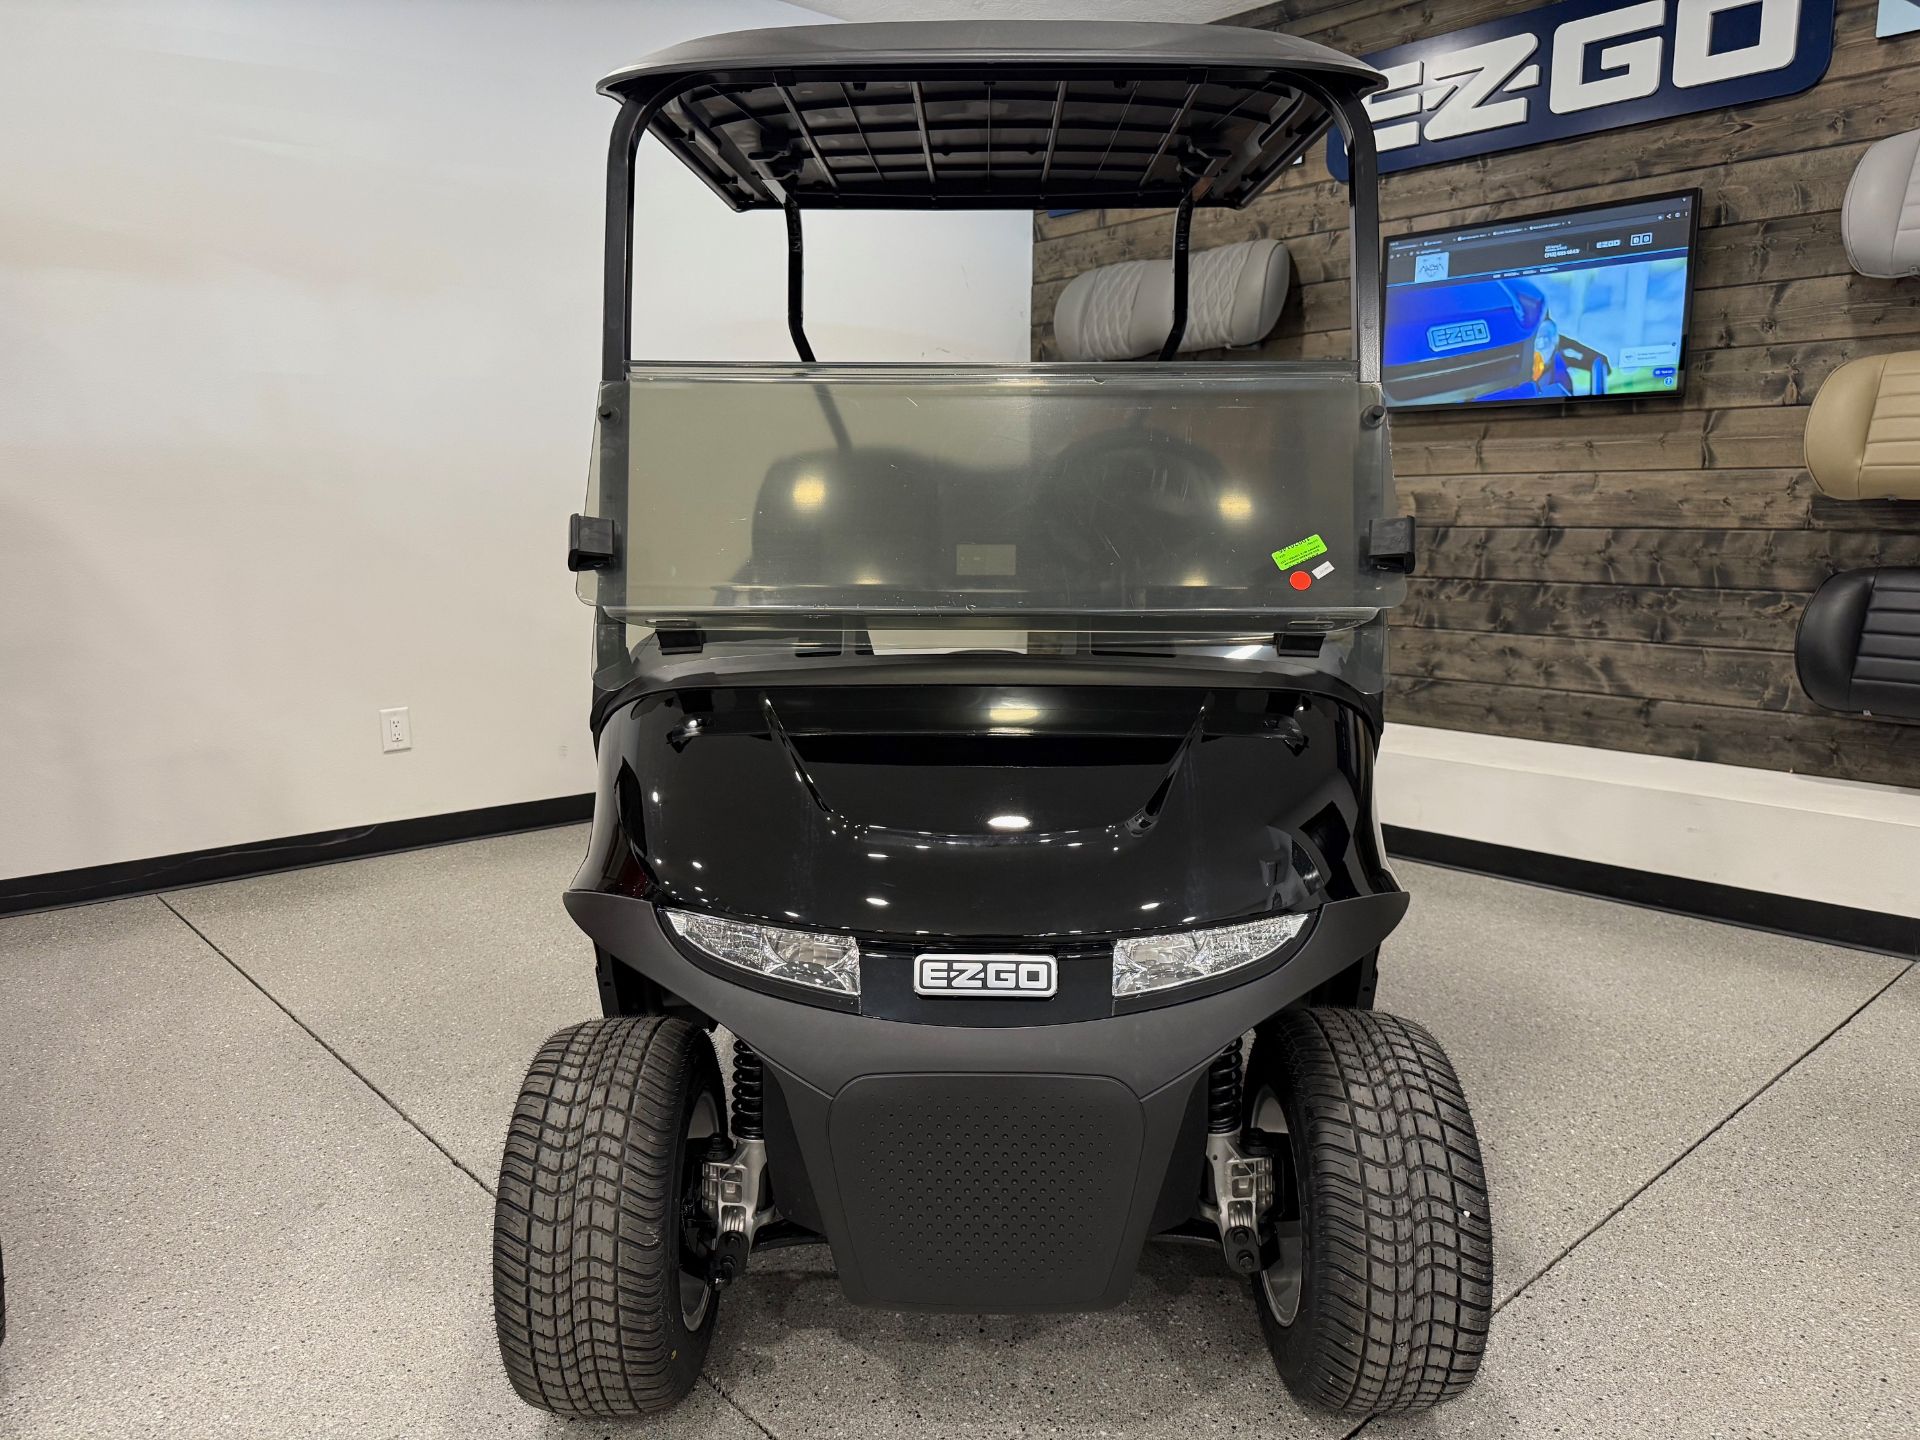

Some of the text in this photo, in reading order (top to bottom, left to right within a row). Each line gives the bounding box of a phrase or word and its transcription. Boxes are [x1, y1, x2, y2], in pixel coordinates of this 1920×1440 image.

[1344, 0, 1798, 156] EZGO
[1432, 323, 1487, 346] EZGO
[922, 962, 1048, 989] EZGO
